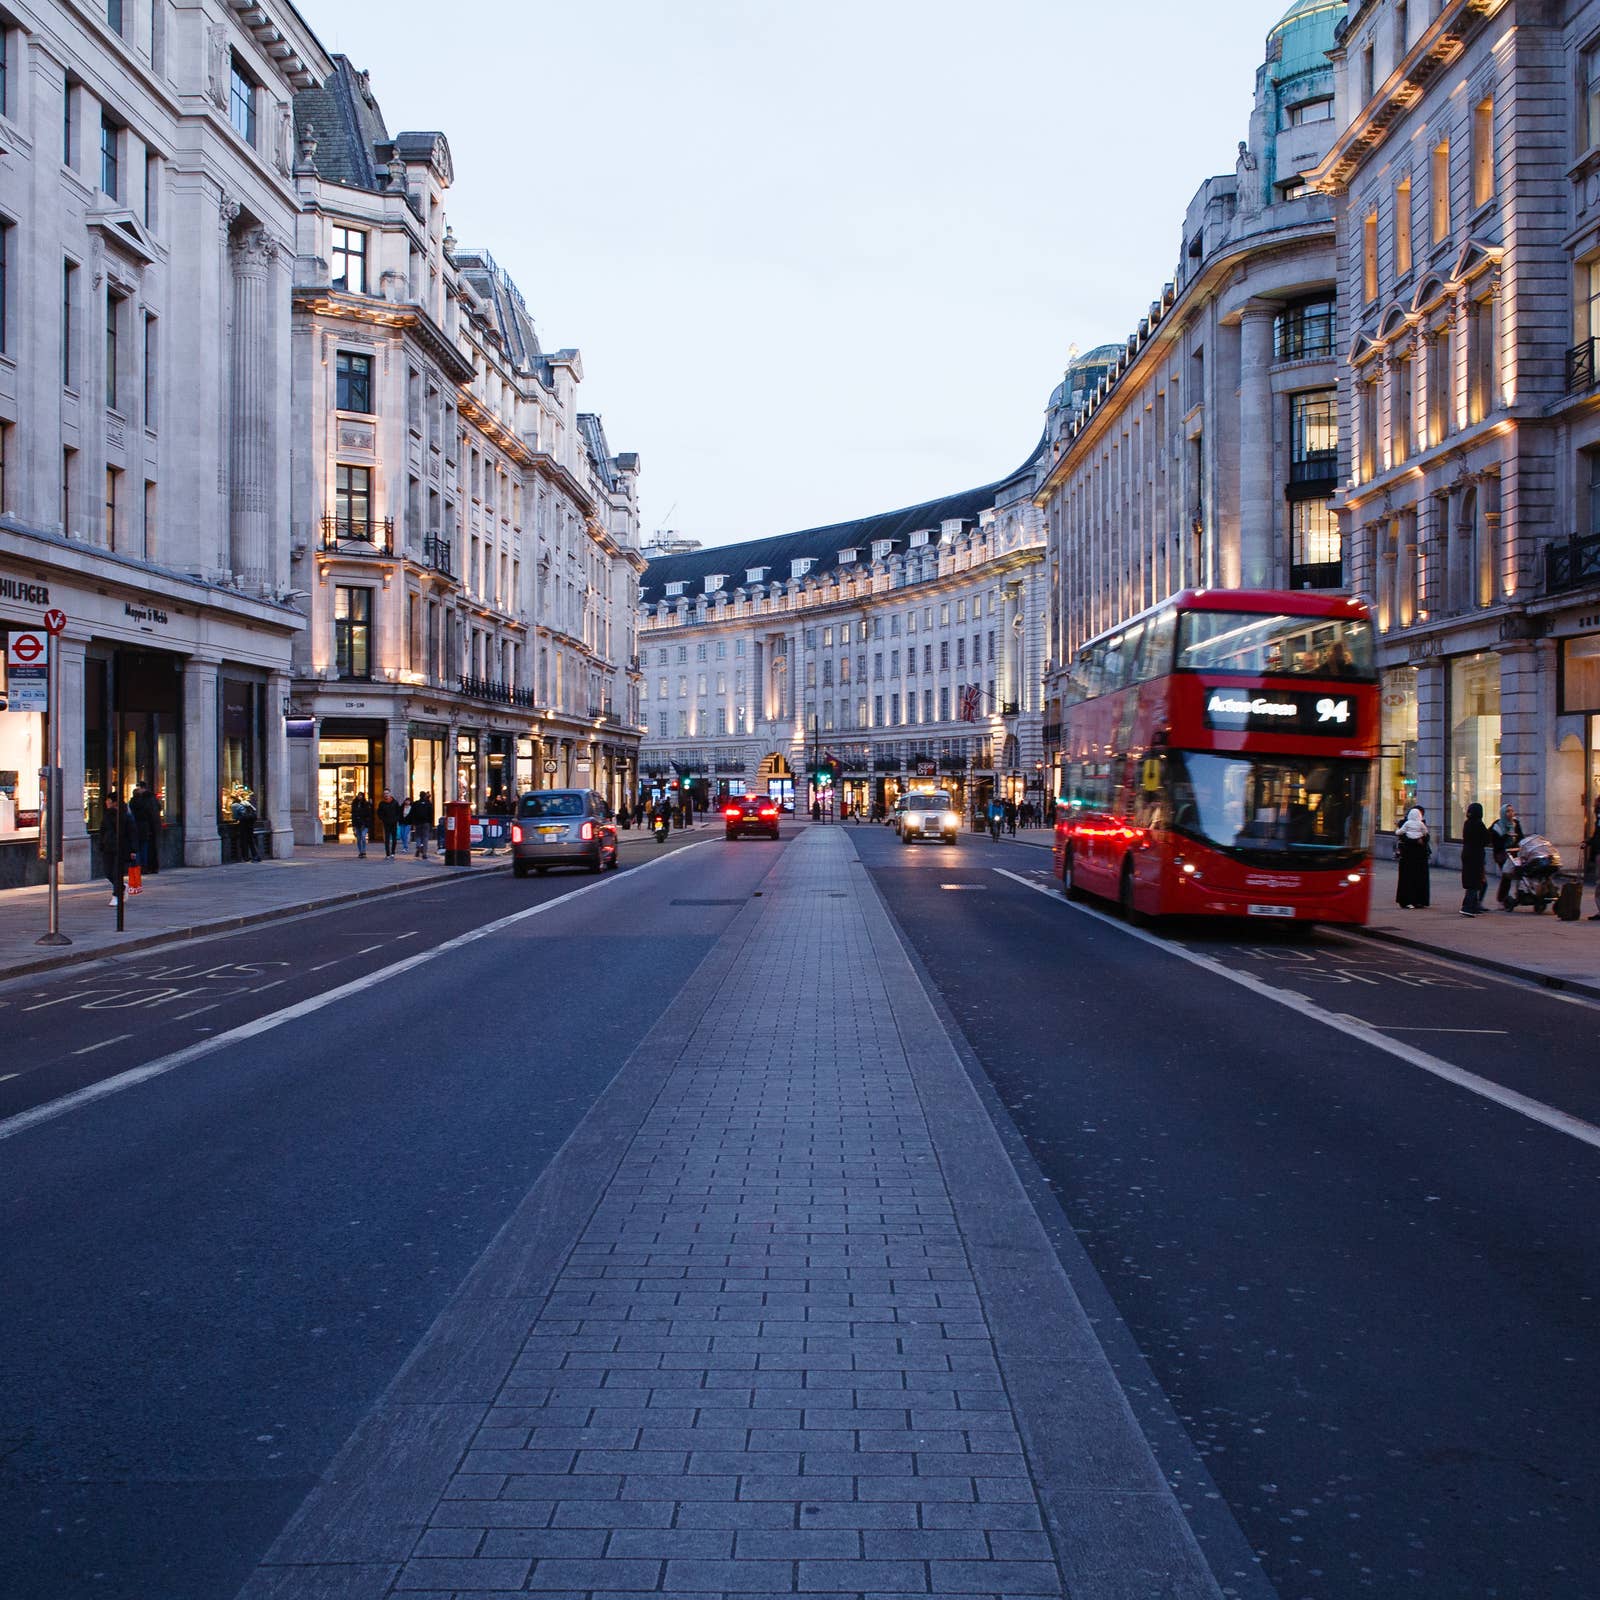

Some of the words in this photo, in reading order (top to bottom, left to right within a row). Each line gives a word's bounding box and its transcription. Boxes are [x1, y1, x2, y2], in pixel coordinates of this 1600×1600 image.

[0, 578, 50, 605] HILFIGER
[125, 602, 147, 623] Mappin
[153, 609, 168, 624] Webb
[1316, 698, 1350, 723] 94
[76, 961, 291, 984] BUS
